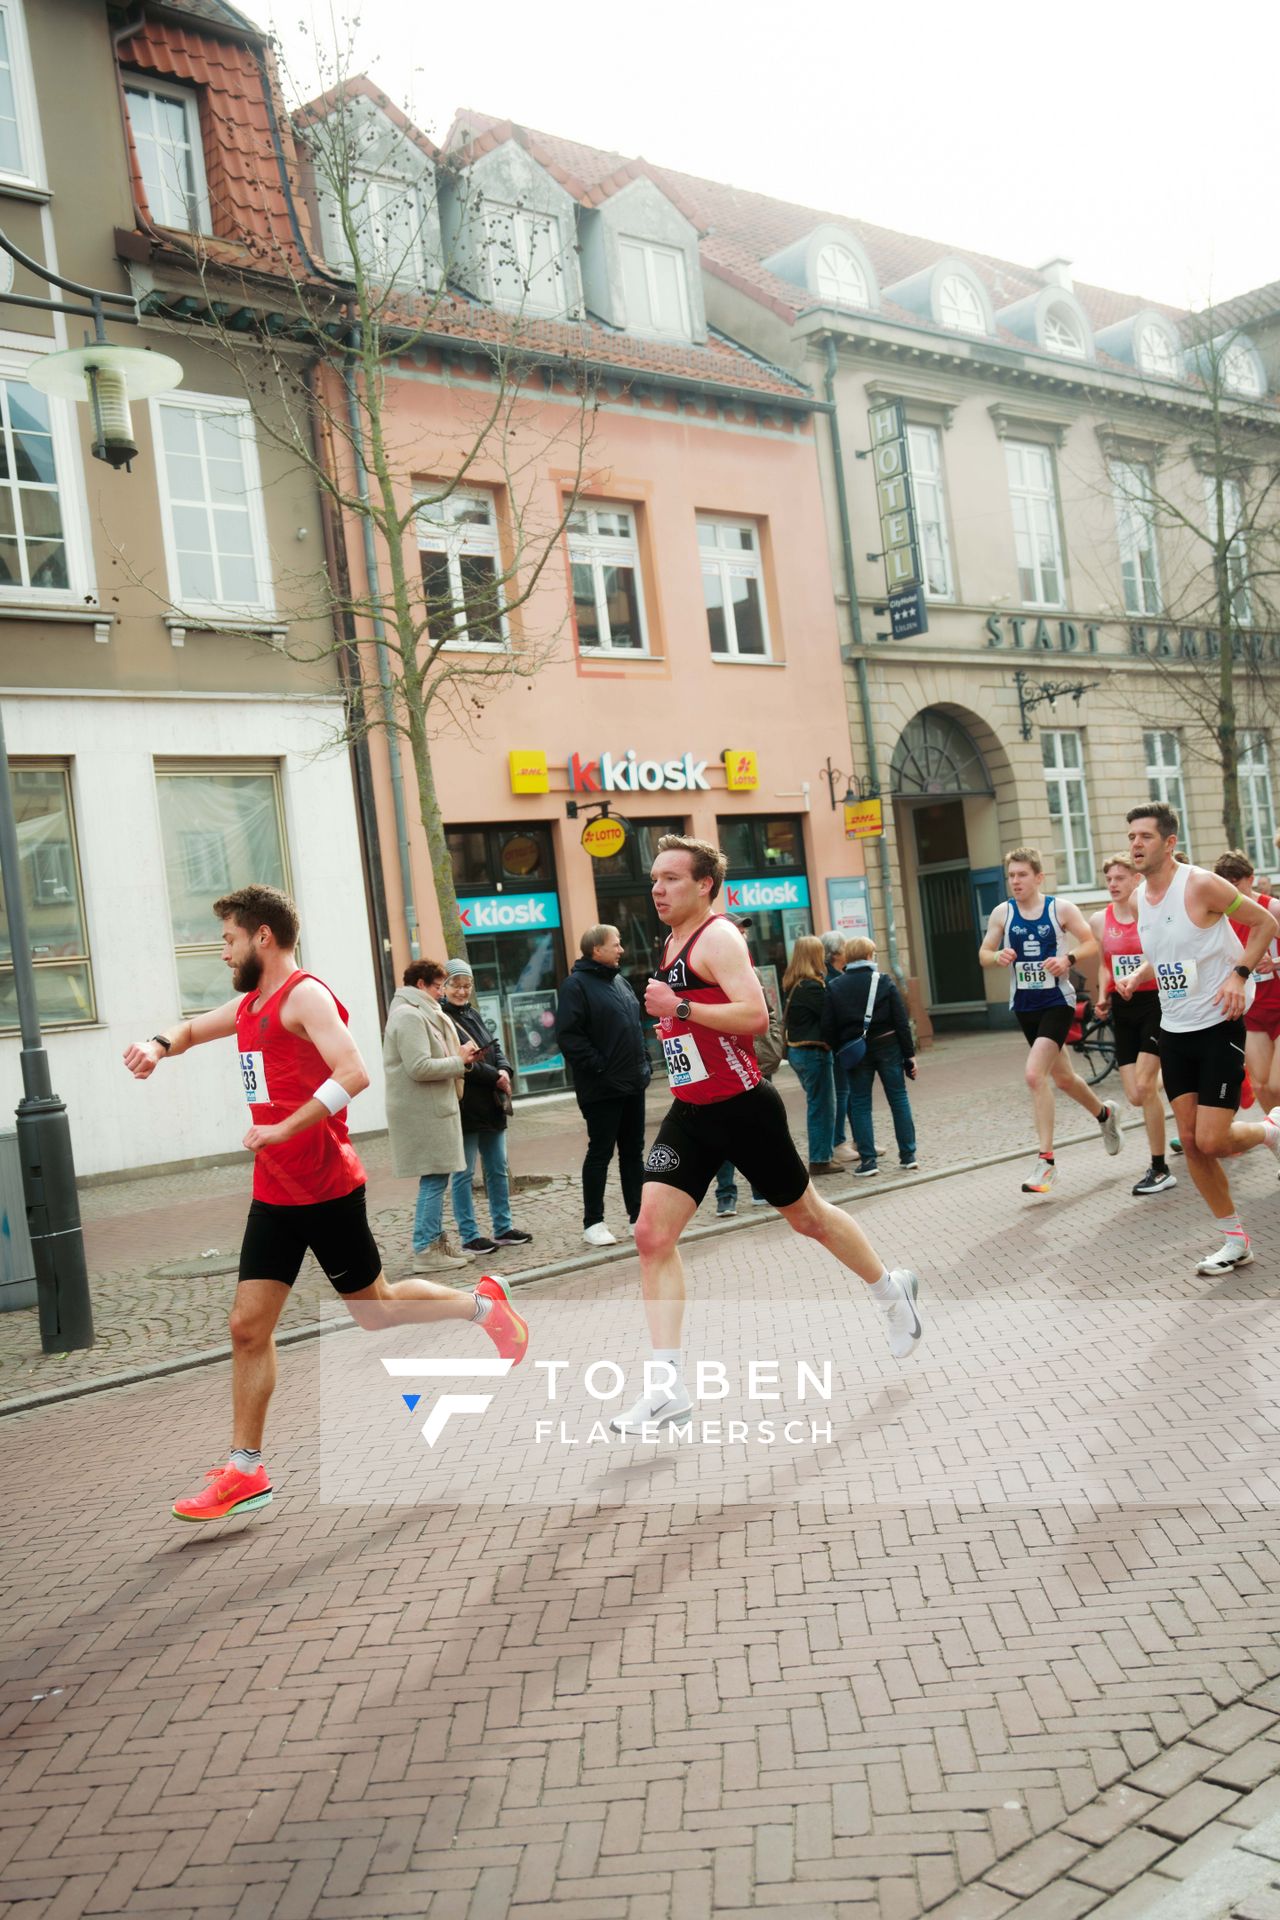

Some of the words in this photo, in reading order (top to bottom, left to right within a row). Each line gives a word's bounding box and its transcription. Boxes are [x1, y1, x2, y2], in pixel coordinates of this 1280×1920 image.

[876, 406, 909, 579] HOTEL
[986, 614, 1100, 653] STADT
[602, 750, 711, 792] kiosk
[734, 775, 757, 785] LOTTO
[595, 828, 622, 841] LOTTO
[742, 881, 799, 906] kiosk
[474, 898, 547, 927] kiosk
[1022, 963, 1044, 972] GLS
[1118, 956, 1142, 965] GLS
[1158, 962, 1184, 976] GLS
[1024, 972, 1047, 983] 618
[664, 1038, 684, 1056] GLS
